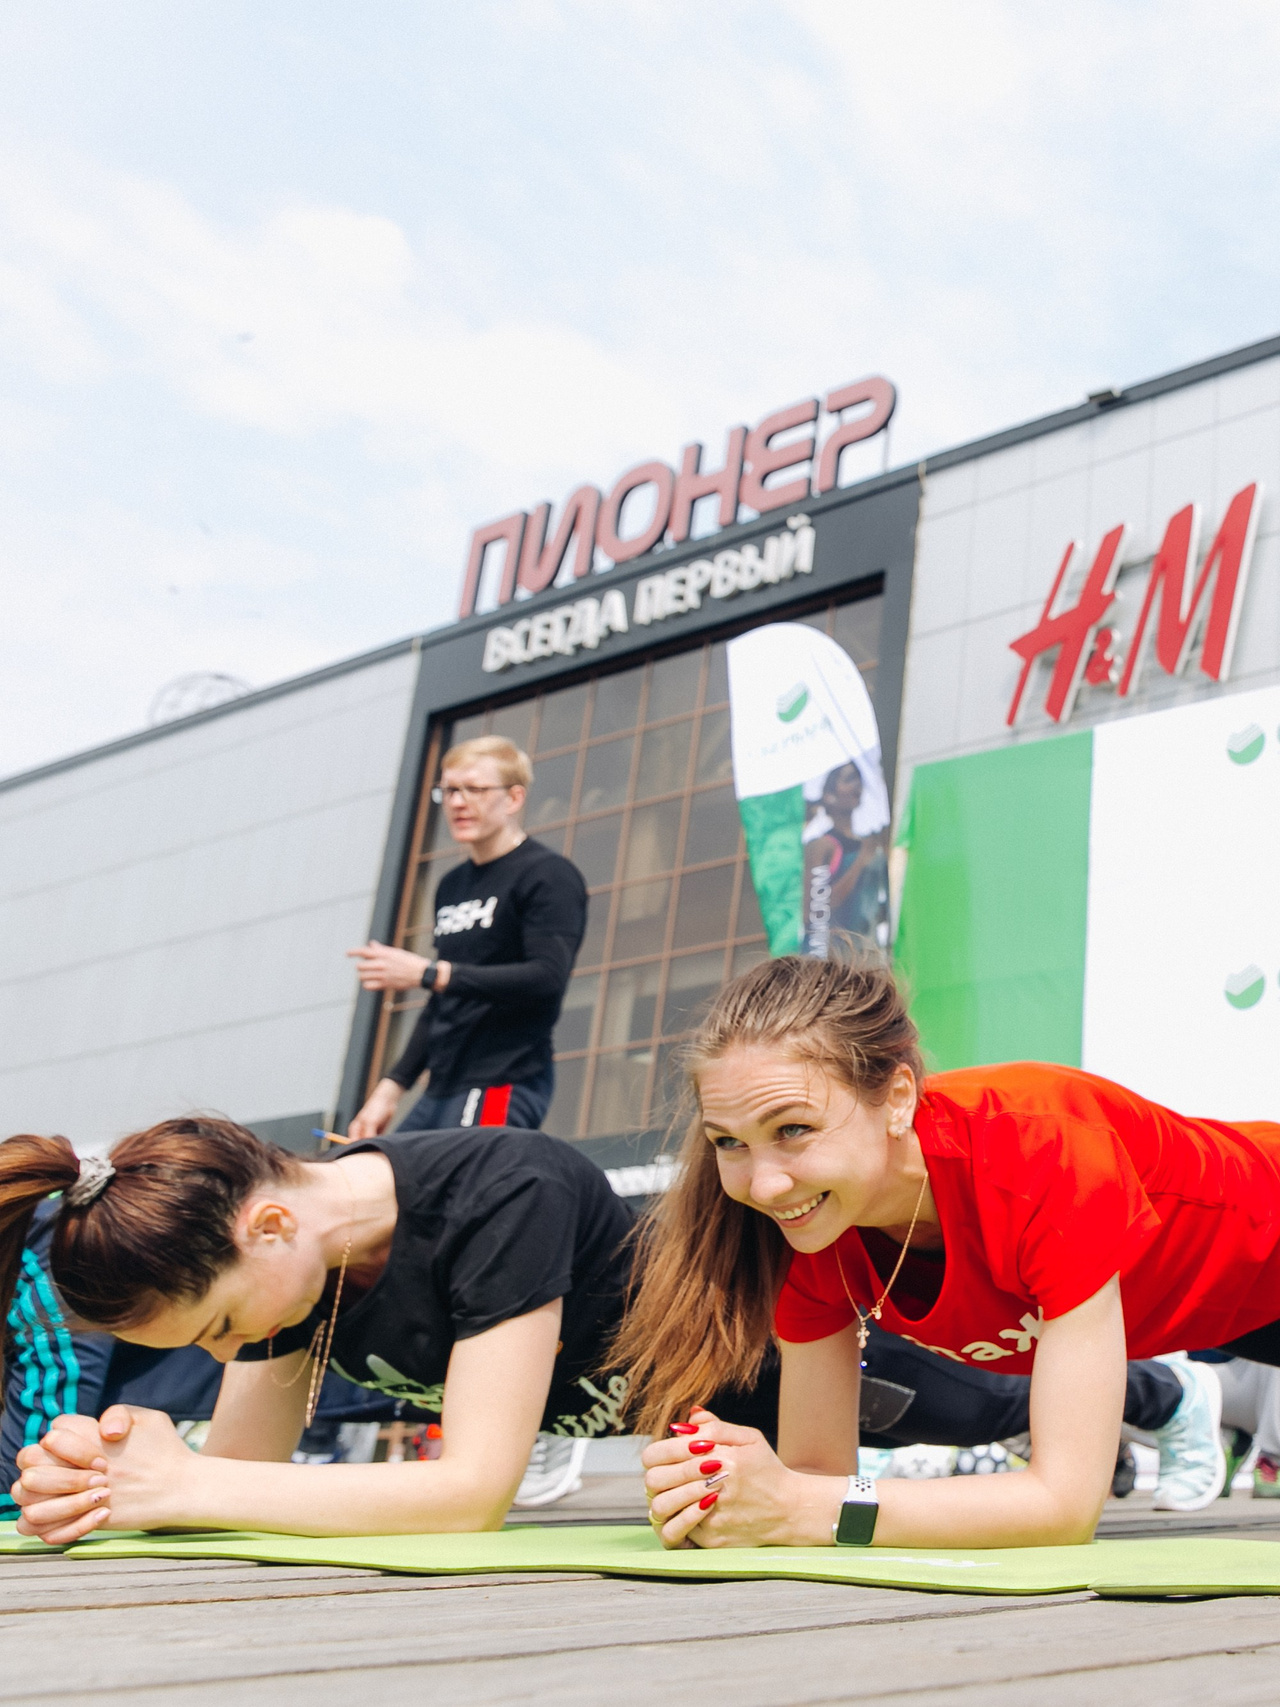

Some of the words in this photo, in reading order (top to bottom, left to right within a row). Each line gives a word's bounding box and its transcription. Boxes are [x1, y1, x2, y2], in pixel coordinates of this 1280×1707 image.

[459, 376, 898, 620] ПИОНЕР
[481, 589, 629, 674] ВСЕГДА
[633, 513, 817, 626] ПЕРВЫЙ
[1006, 482, 1264, 727] H&M
